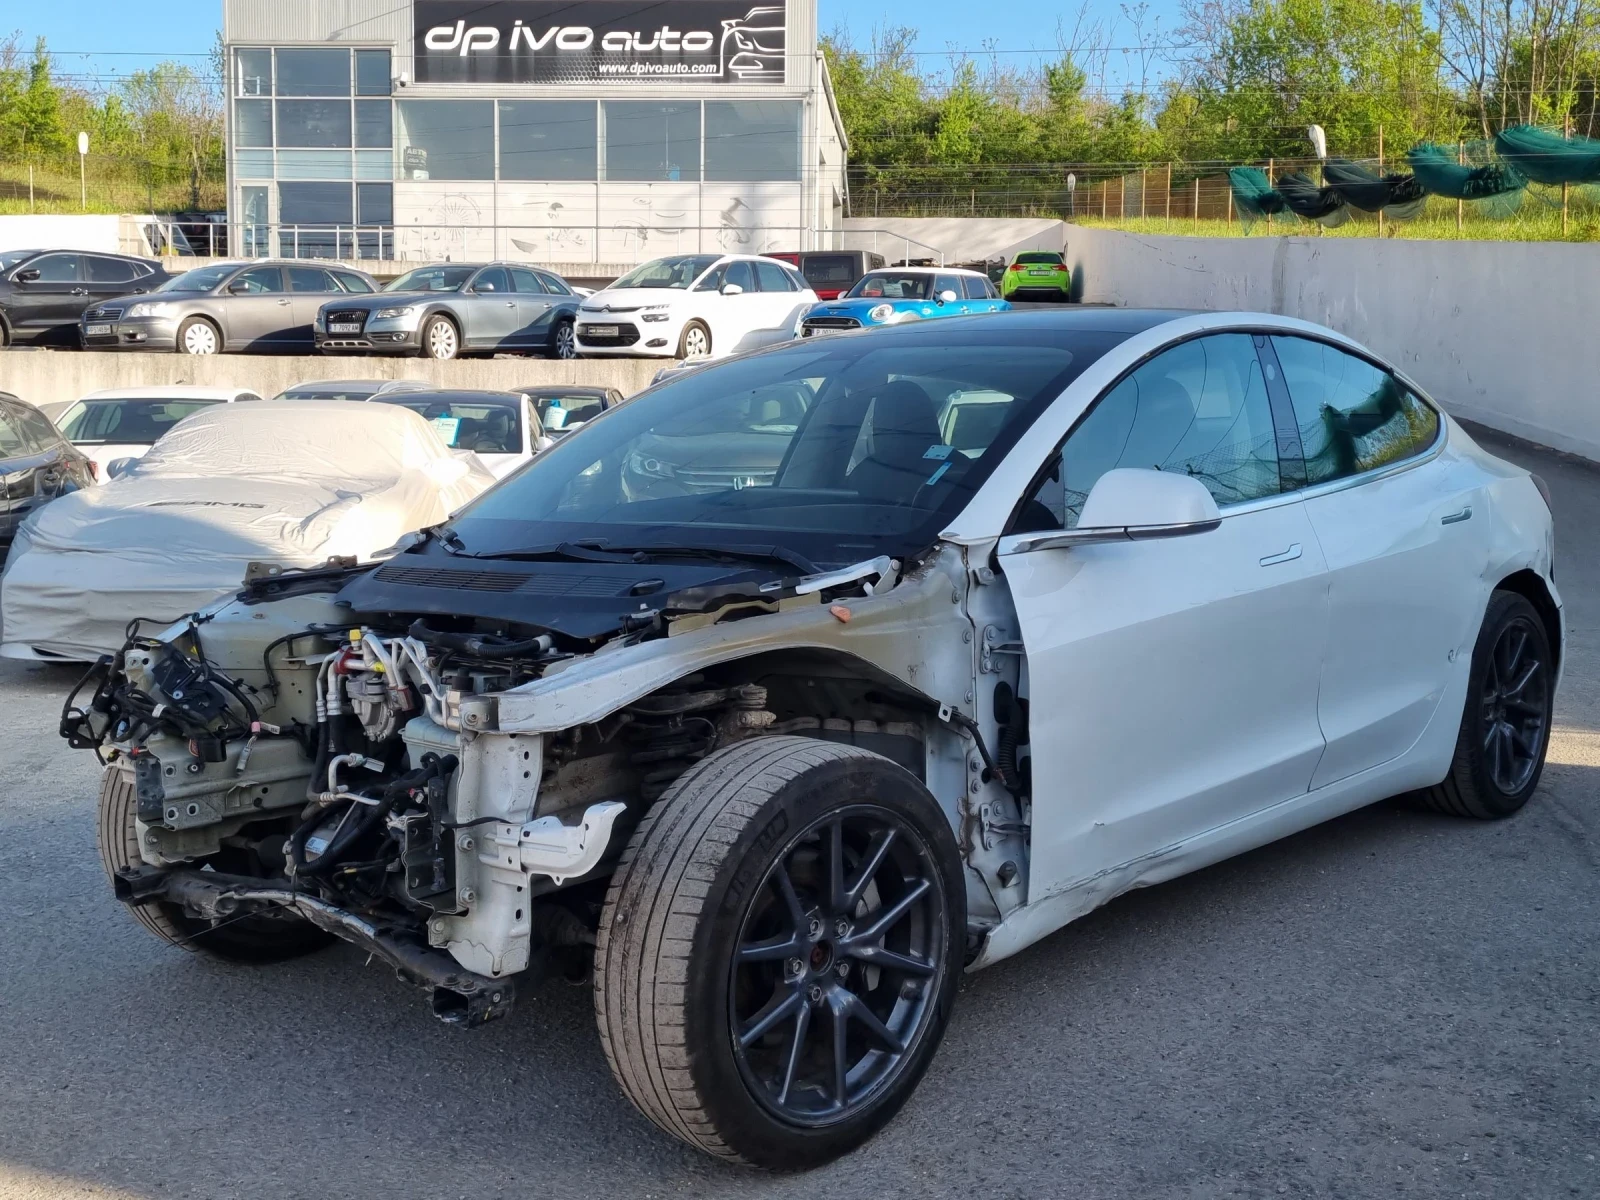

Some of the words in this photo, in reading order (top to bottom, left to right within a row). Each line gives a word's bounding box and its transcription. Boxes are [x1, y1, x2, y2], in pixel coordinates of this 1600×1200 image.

[424, 20, 500, 57] dp
[509, 20, 594, 51] ivo
[601, 25, 714, 51] auto
[598, 62, 717, 75] www.dpivoauto.com
